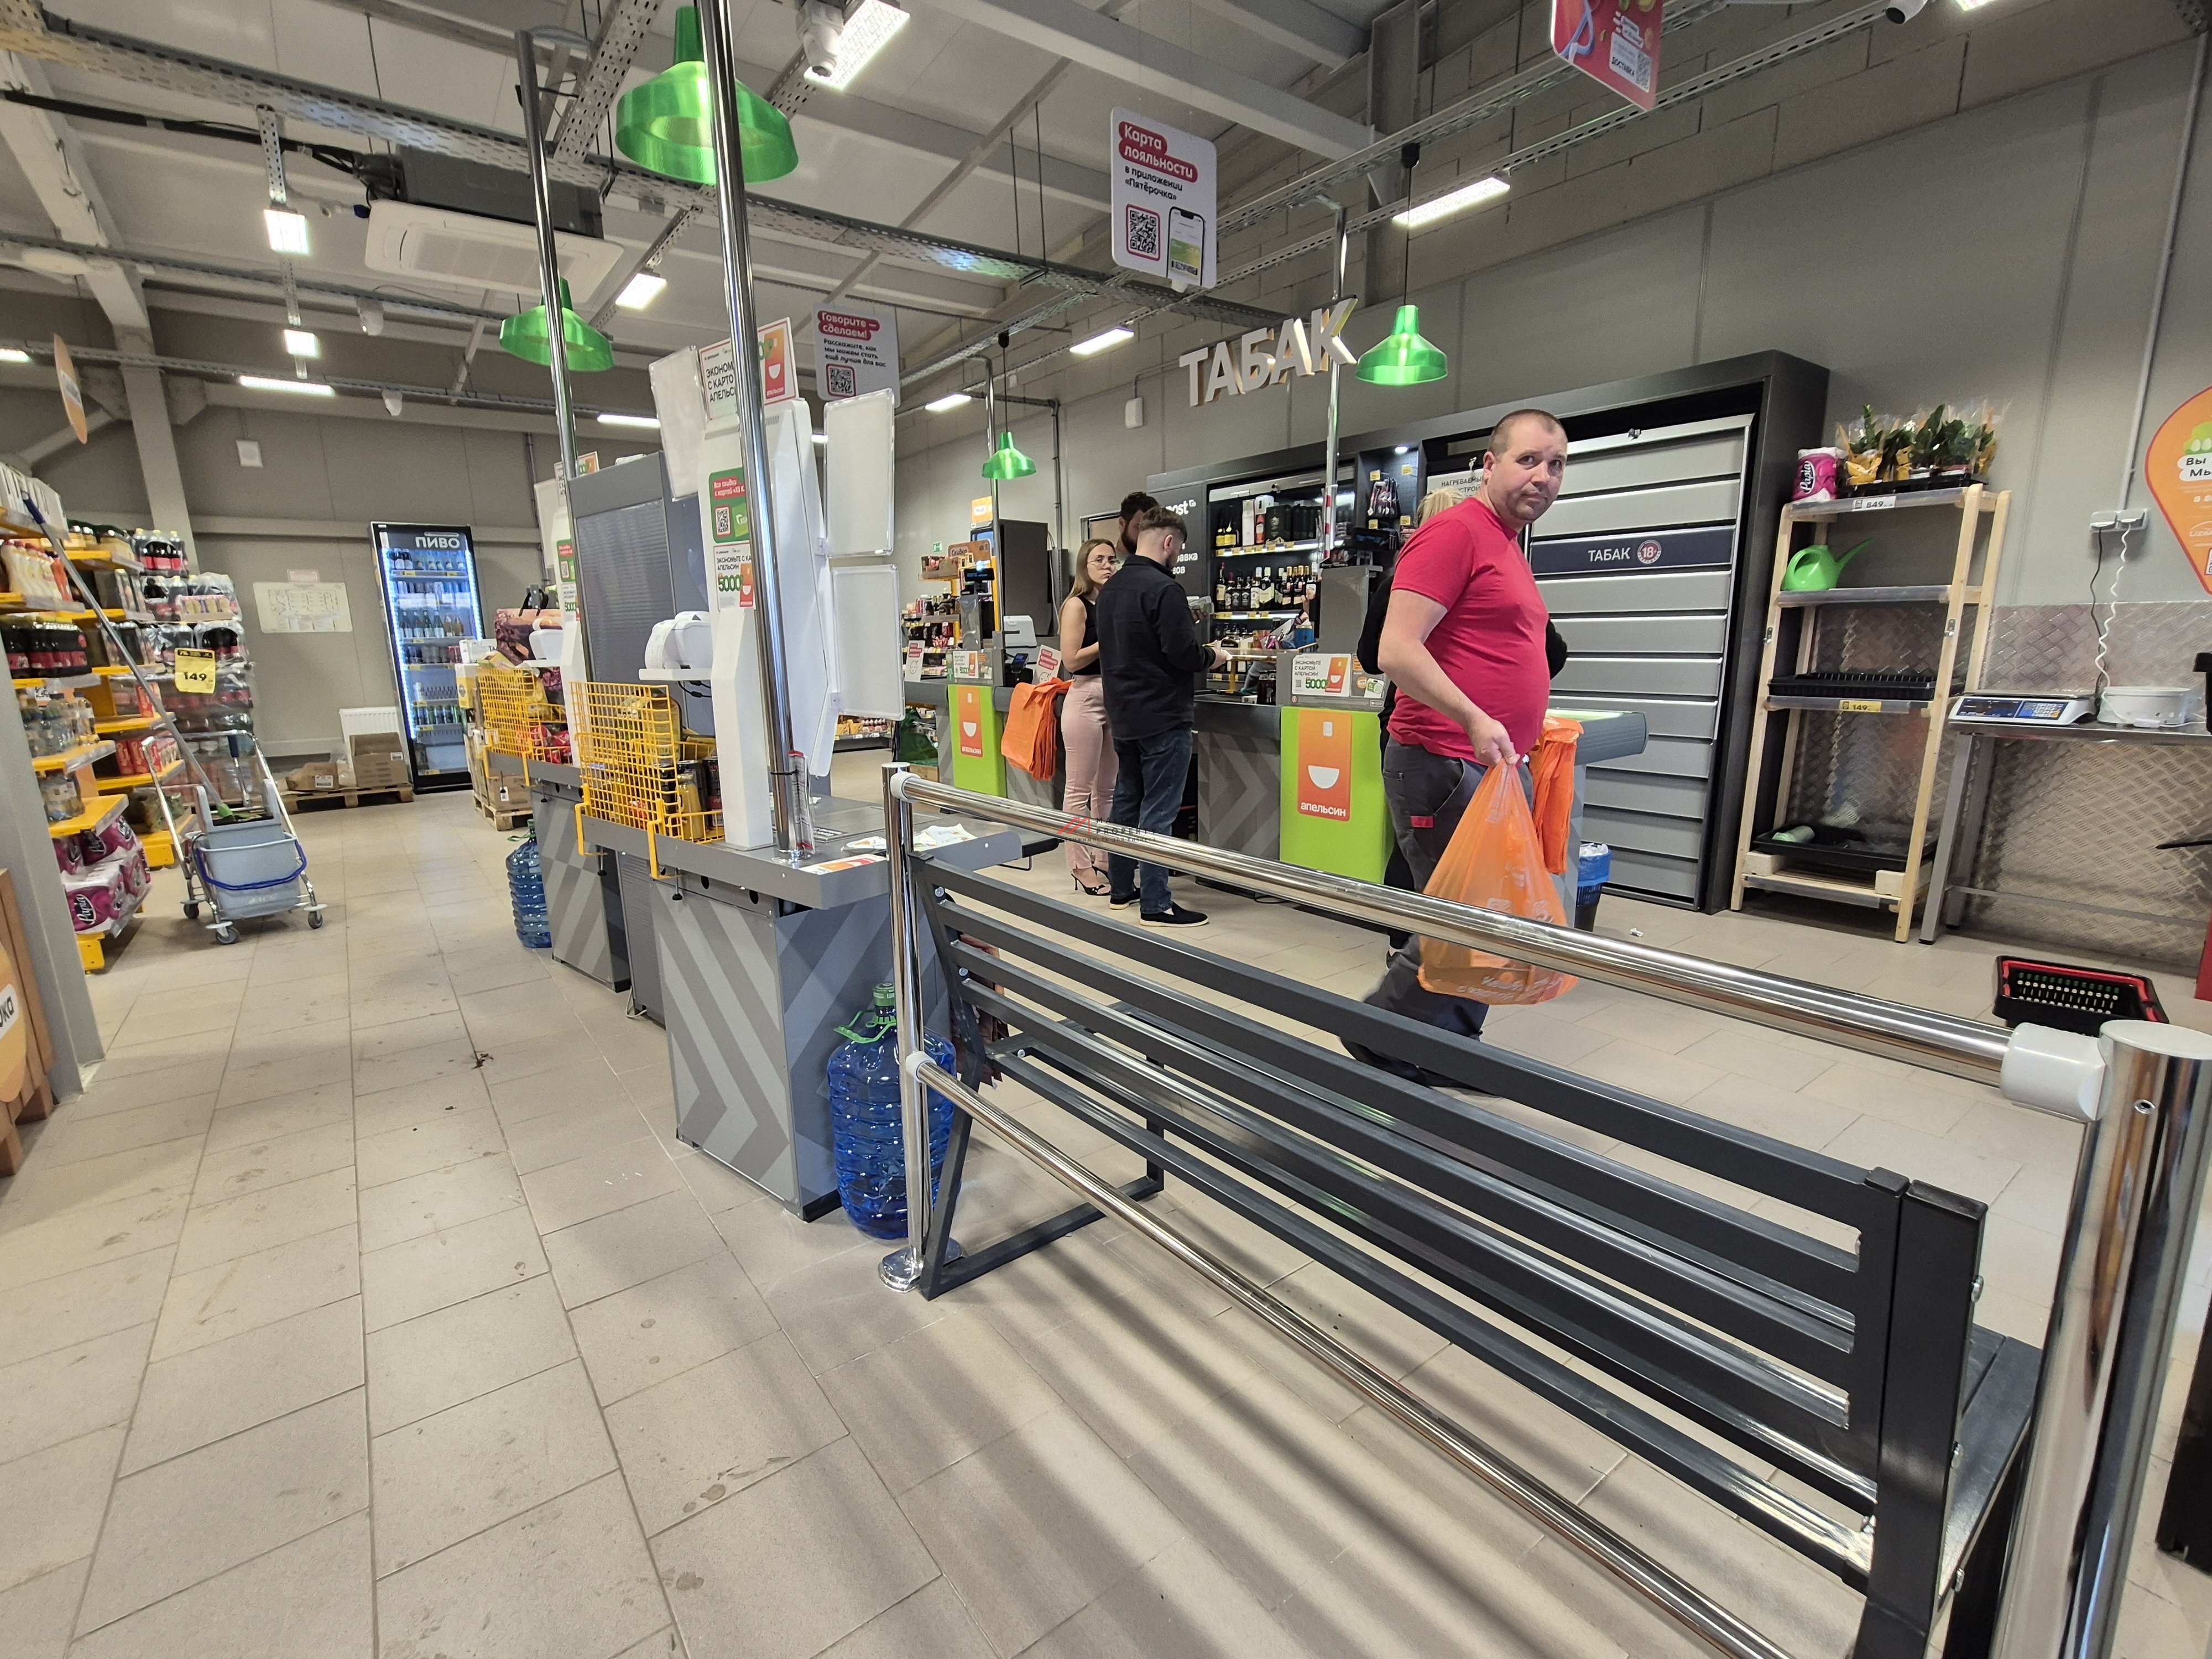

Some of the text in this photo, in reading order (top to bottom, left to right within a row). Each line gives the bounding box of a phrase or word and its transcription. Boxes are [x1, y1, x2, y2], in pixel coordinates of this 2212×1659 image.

[1124, 124, 1162, 150] Карта
[1124, 144, 1193, 178] лояльности
[1132, 168, 1182, 192] приложении
[1125, 178, 1177, 200] «Пятёрочка»
[822, 312, 866, 327] Говорите
[823, 324, 867, 338] сделаем!
[824, 338, 864, 350] Расскажите,
[1179, 298, 1358, 406] ТАБАК
[706, 361, 734, 378] ЭКОНОМ
[708, 374, 734, 390] С КАРТО
[709, 387, 734, 403] АПЕЛЬС
[1441, 477, 1483, 487] НАГРЕВАЕМЫ
[1799, 461, 1814, 492] Papia
[415, 536, 460, 549] ПИВО
[1588, 547, 1630, 562] ТАБАК
[1642, 546, 1657, 558] 18+
[184, 672, 207, 681] 149
[1301, 802, 1346, 816] апельсин
